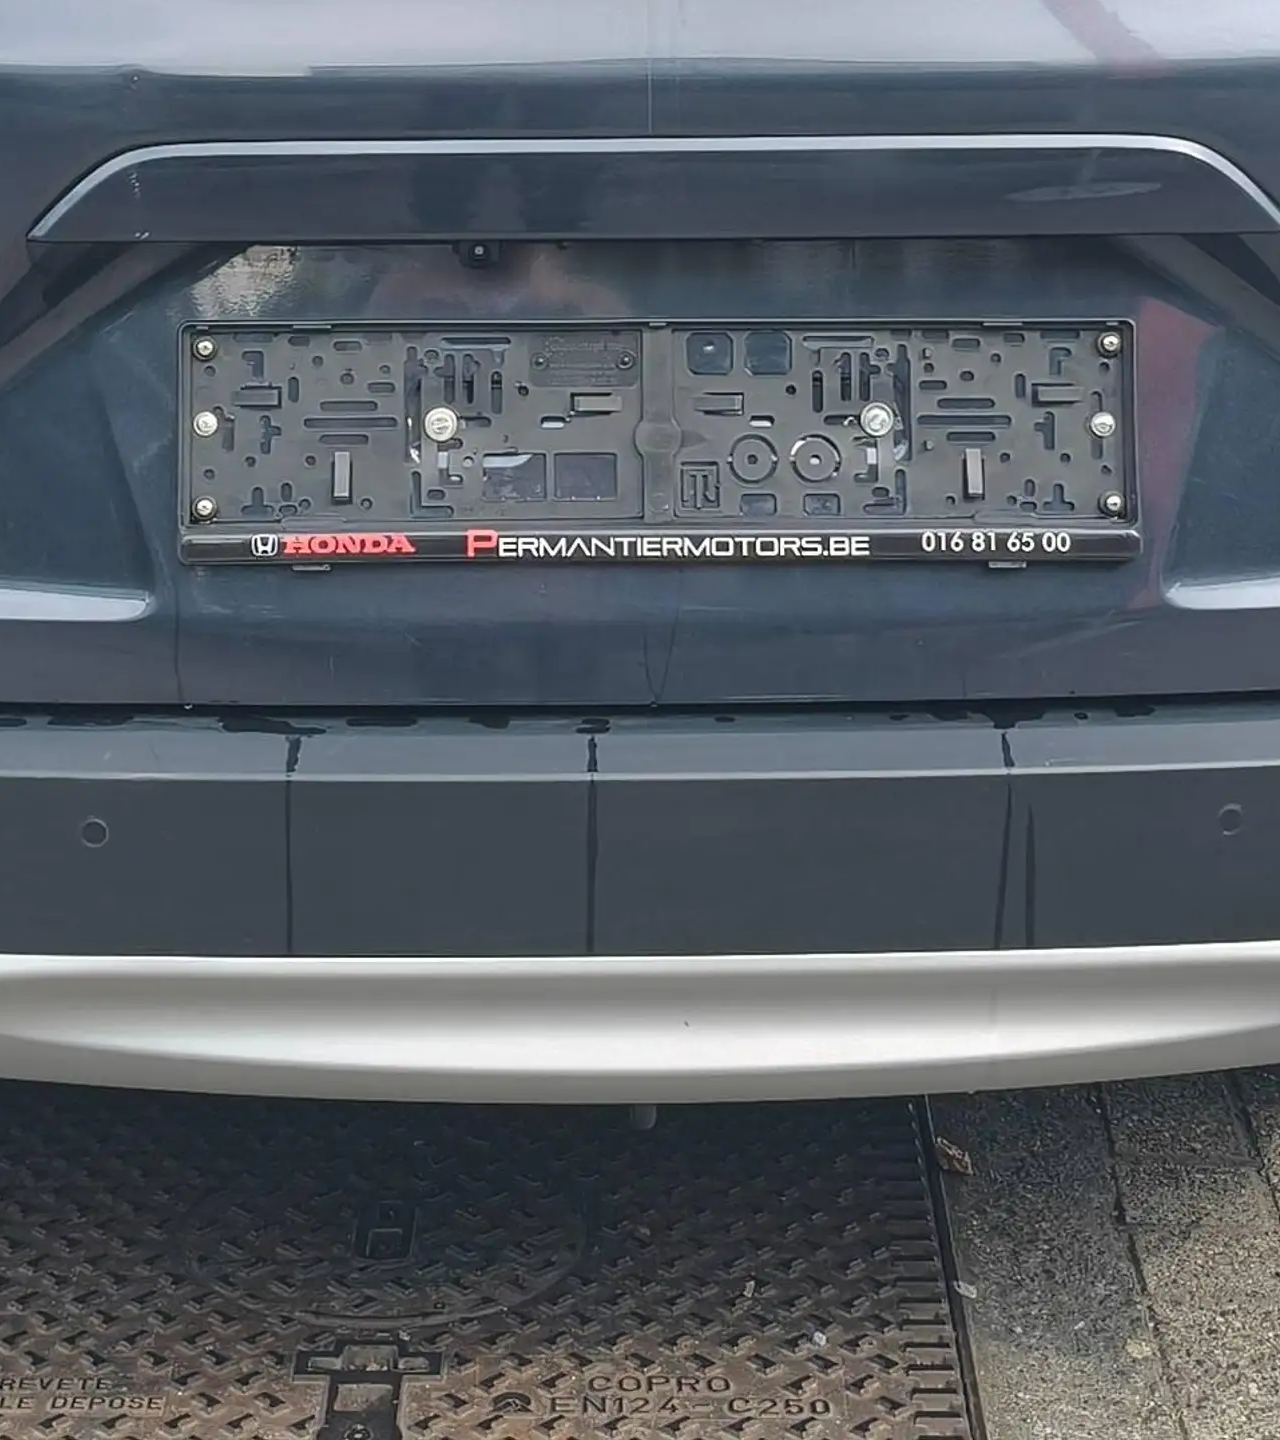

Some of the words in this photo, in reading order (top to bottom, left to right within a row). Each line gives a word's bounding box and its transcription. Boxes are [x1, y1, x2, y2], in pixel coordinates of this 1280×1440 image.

[283, 533, 416, 555] HONDA
[466, 529, 870, 558] PERMANTIERMOTORS.BE
[921, 531, 964, 552] 016
[971, 531, 997, 552] 81
[1007, 531, 1035, 552] 65
[1042, 531, 1071, 552] 00
[587, 1374, 732, 1394] COPRO
[49, 1395, 164, 1411] DEPOSE
[549, 1396, 680, 1416] EN124
[727, 1396, 832, 1417] C250
